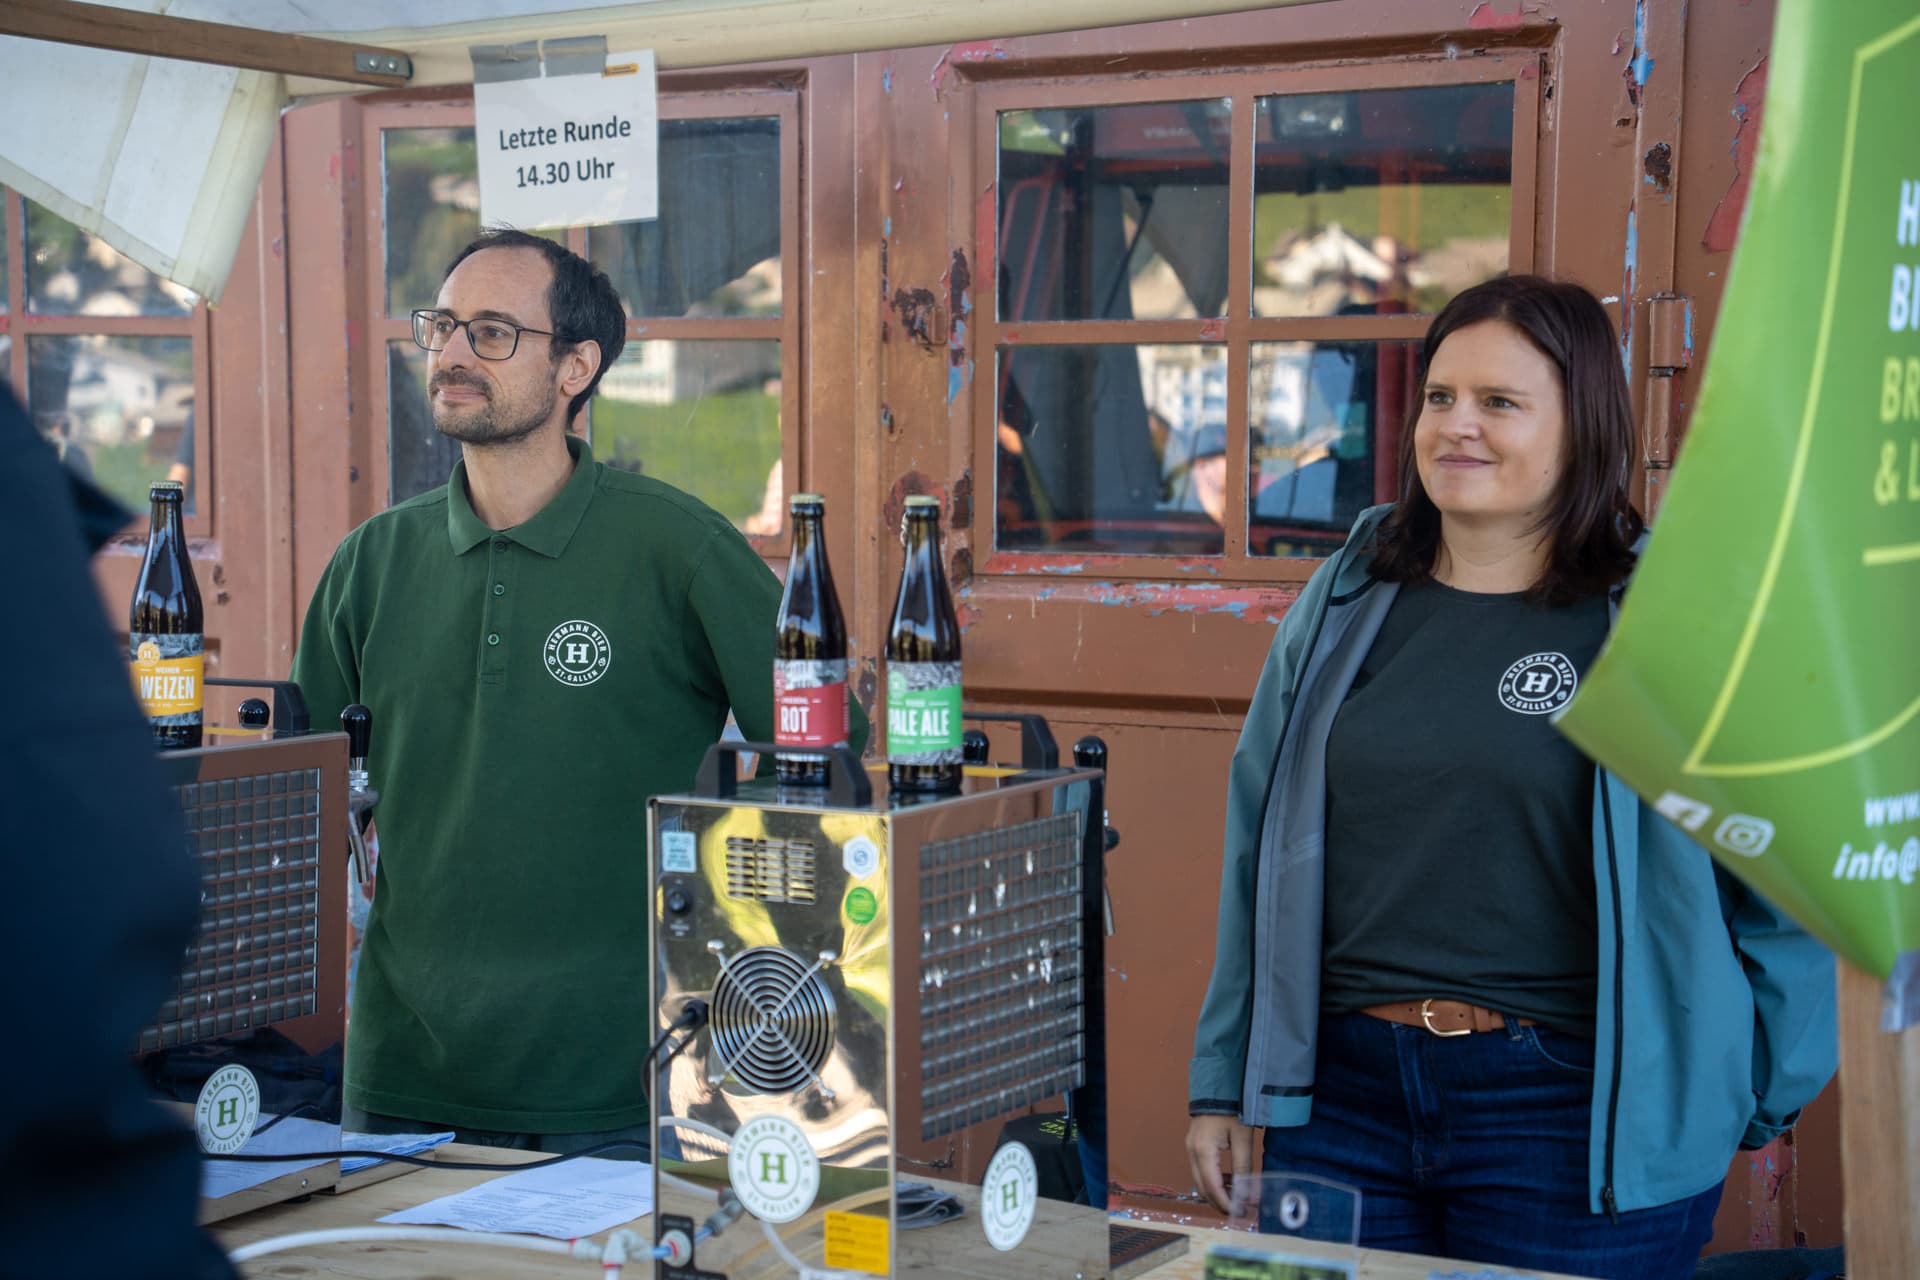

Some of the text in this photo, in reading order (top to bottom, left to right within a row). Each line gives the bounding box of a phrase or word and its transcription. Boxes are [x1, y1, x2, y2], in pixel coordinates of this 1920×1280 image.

[499, 115, 631, 151] Letzte Runde
[516, 157, 615, 188] 14.30 Uhr
[1873, 438, 1900, 506] &
[547, 623, 607, 652] HERMANN BIER
[565, 642, 590, 664] H
[1507, 655, 1572, 685] HERMANN BIER
[1520, 671, 1553, 693] H
[140, 675, 195, 700] WEIZEN
[780, 706, 809, 733] ROT
[887, 708, 950, 737] PALE ALE
[200, 1072, 255, 1114] HERMANN BIER
[216, 1097, 239, 1128] H
[759, 1151, 787, 1184] H
[1001, 1179, 1018, 1214] H
